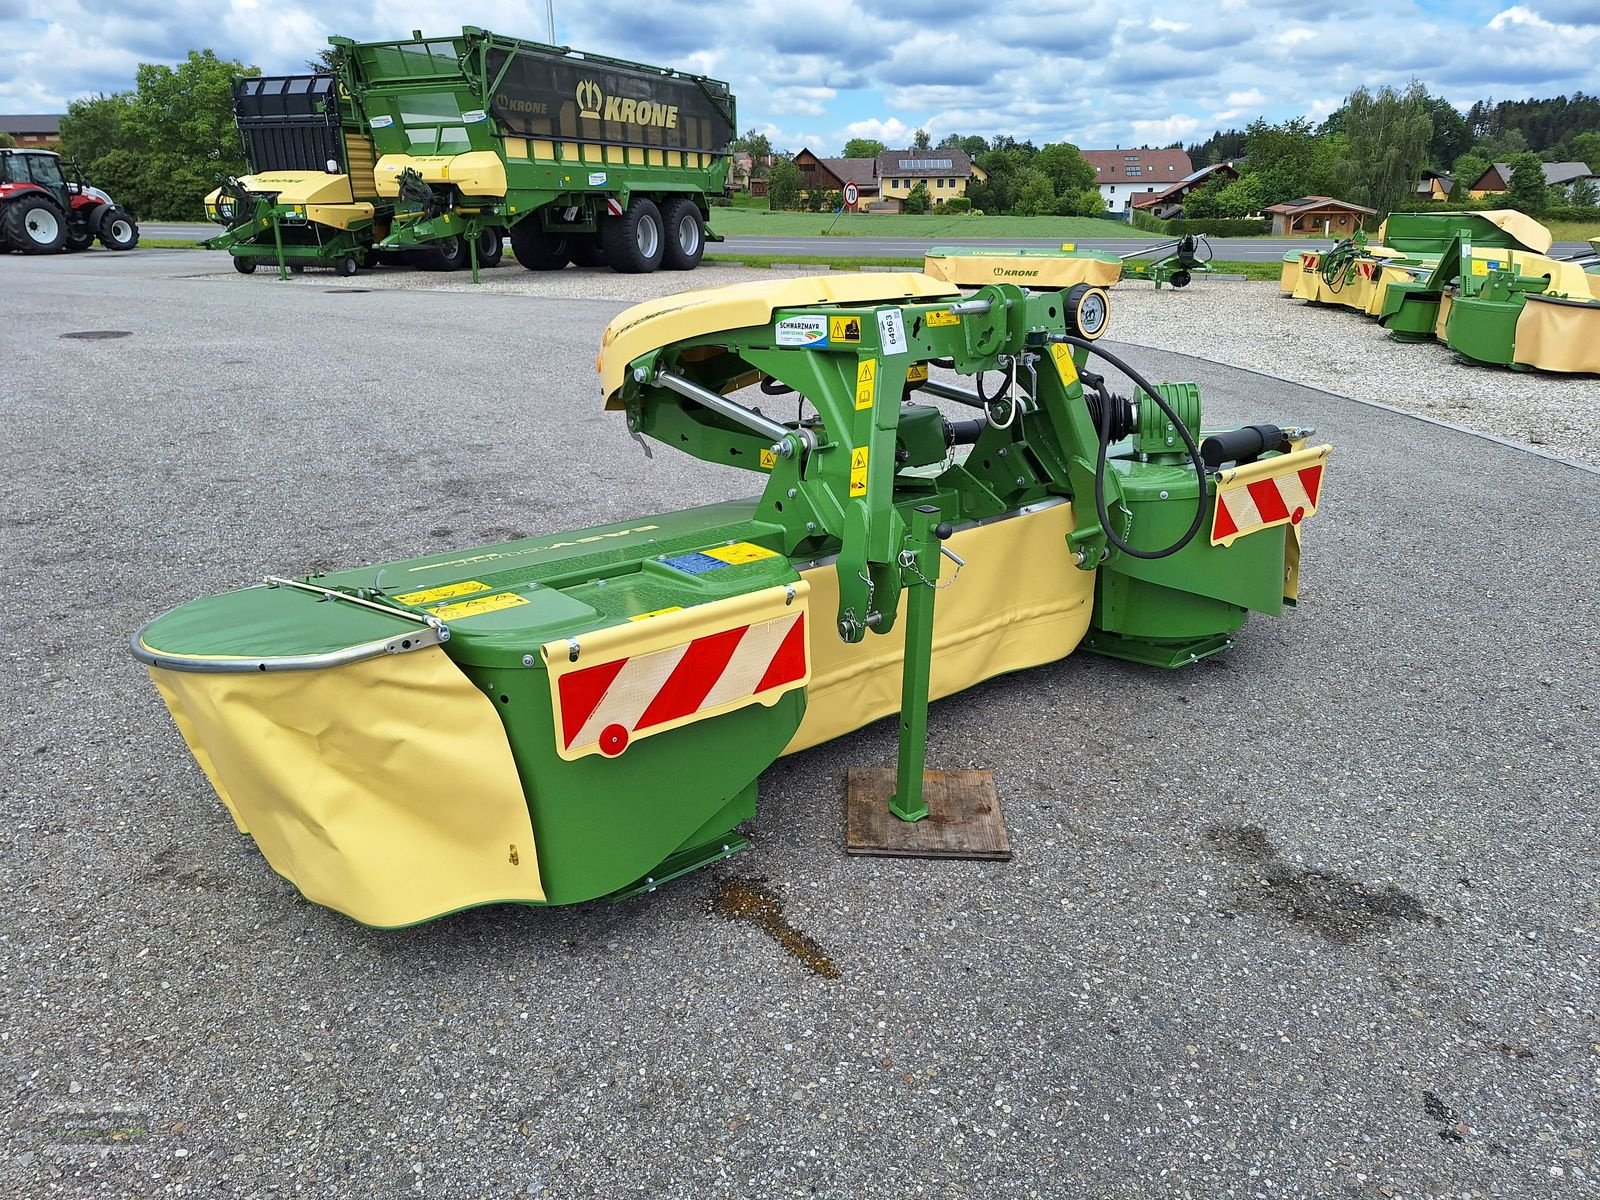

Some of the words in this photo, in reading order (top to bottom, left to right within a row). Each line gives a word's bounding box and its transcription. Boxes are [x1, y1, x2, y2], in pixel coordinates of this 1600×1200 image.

[509, 99, 547, 114] KRONE
[603, 95, 678, 128] KRONE
[848, 188, 856, 201] 70
[1004, 269, 1039, 277] KRONE
[779, 321, 820, 330] SCHWARZMAYR
[885, 314, 897, 345] 64963
